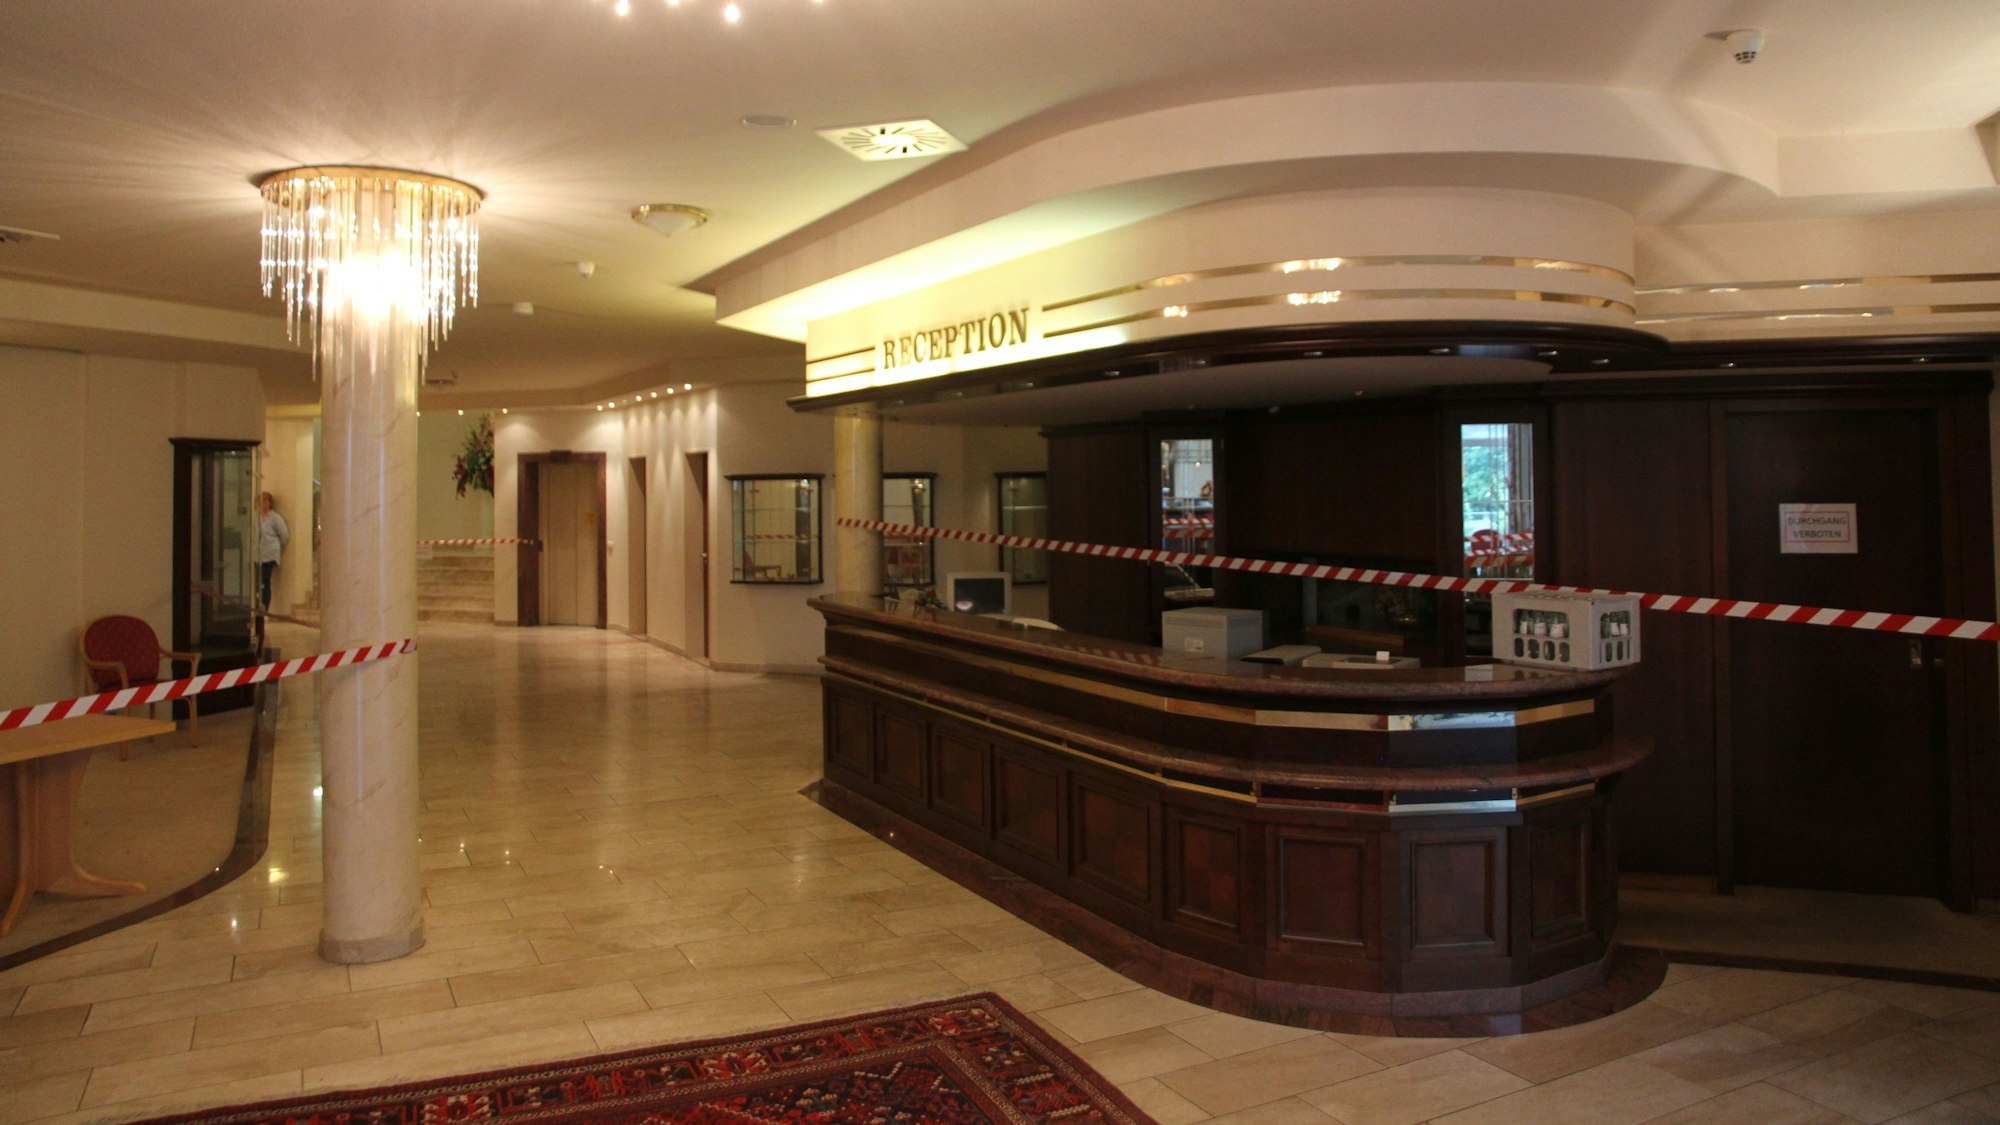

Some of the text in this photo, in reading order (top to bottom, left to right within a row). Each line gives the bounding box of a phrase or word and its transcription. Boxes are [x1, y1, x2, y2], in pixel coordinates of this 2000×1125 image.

[883, 308, 1029, 369] RECEPTION
[1787, 517, 1847, 526] DURCHGANG
[1792, 529, 1842, 538] VERBOTEN
